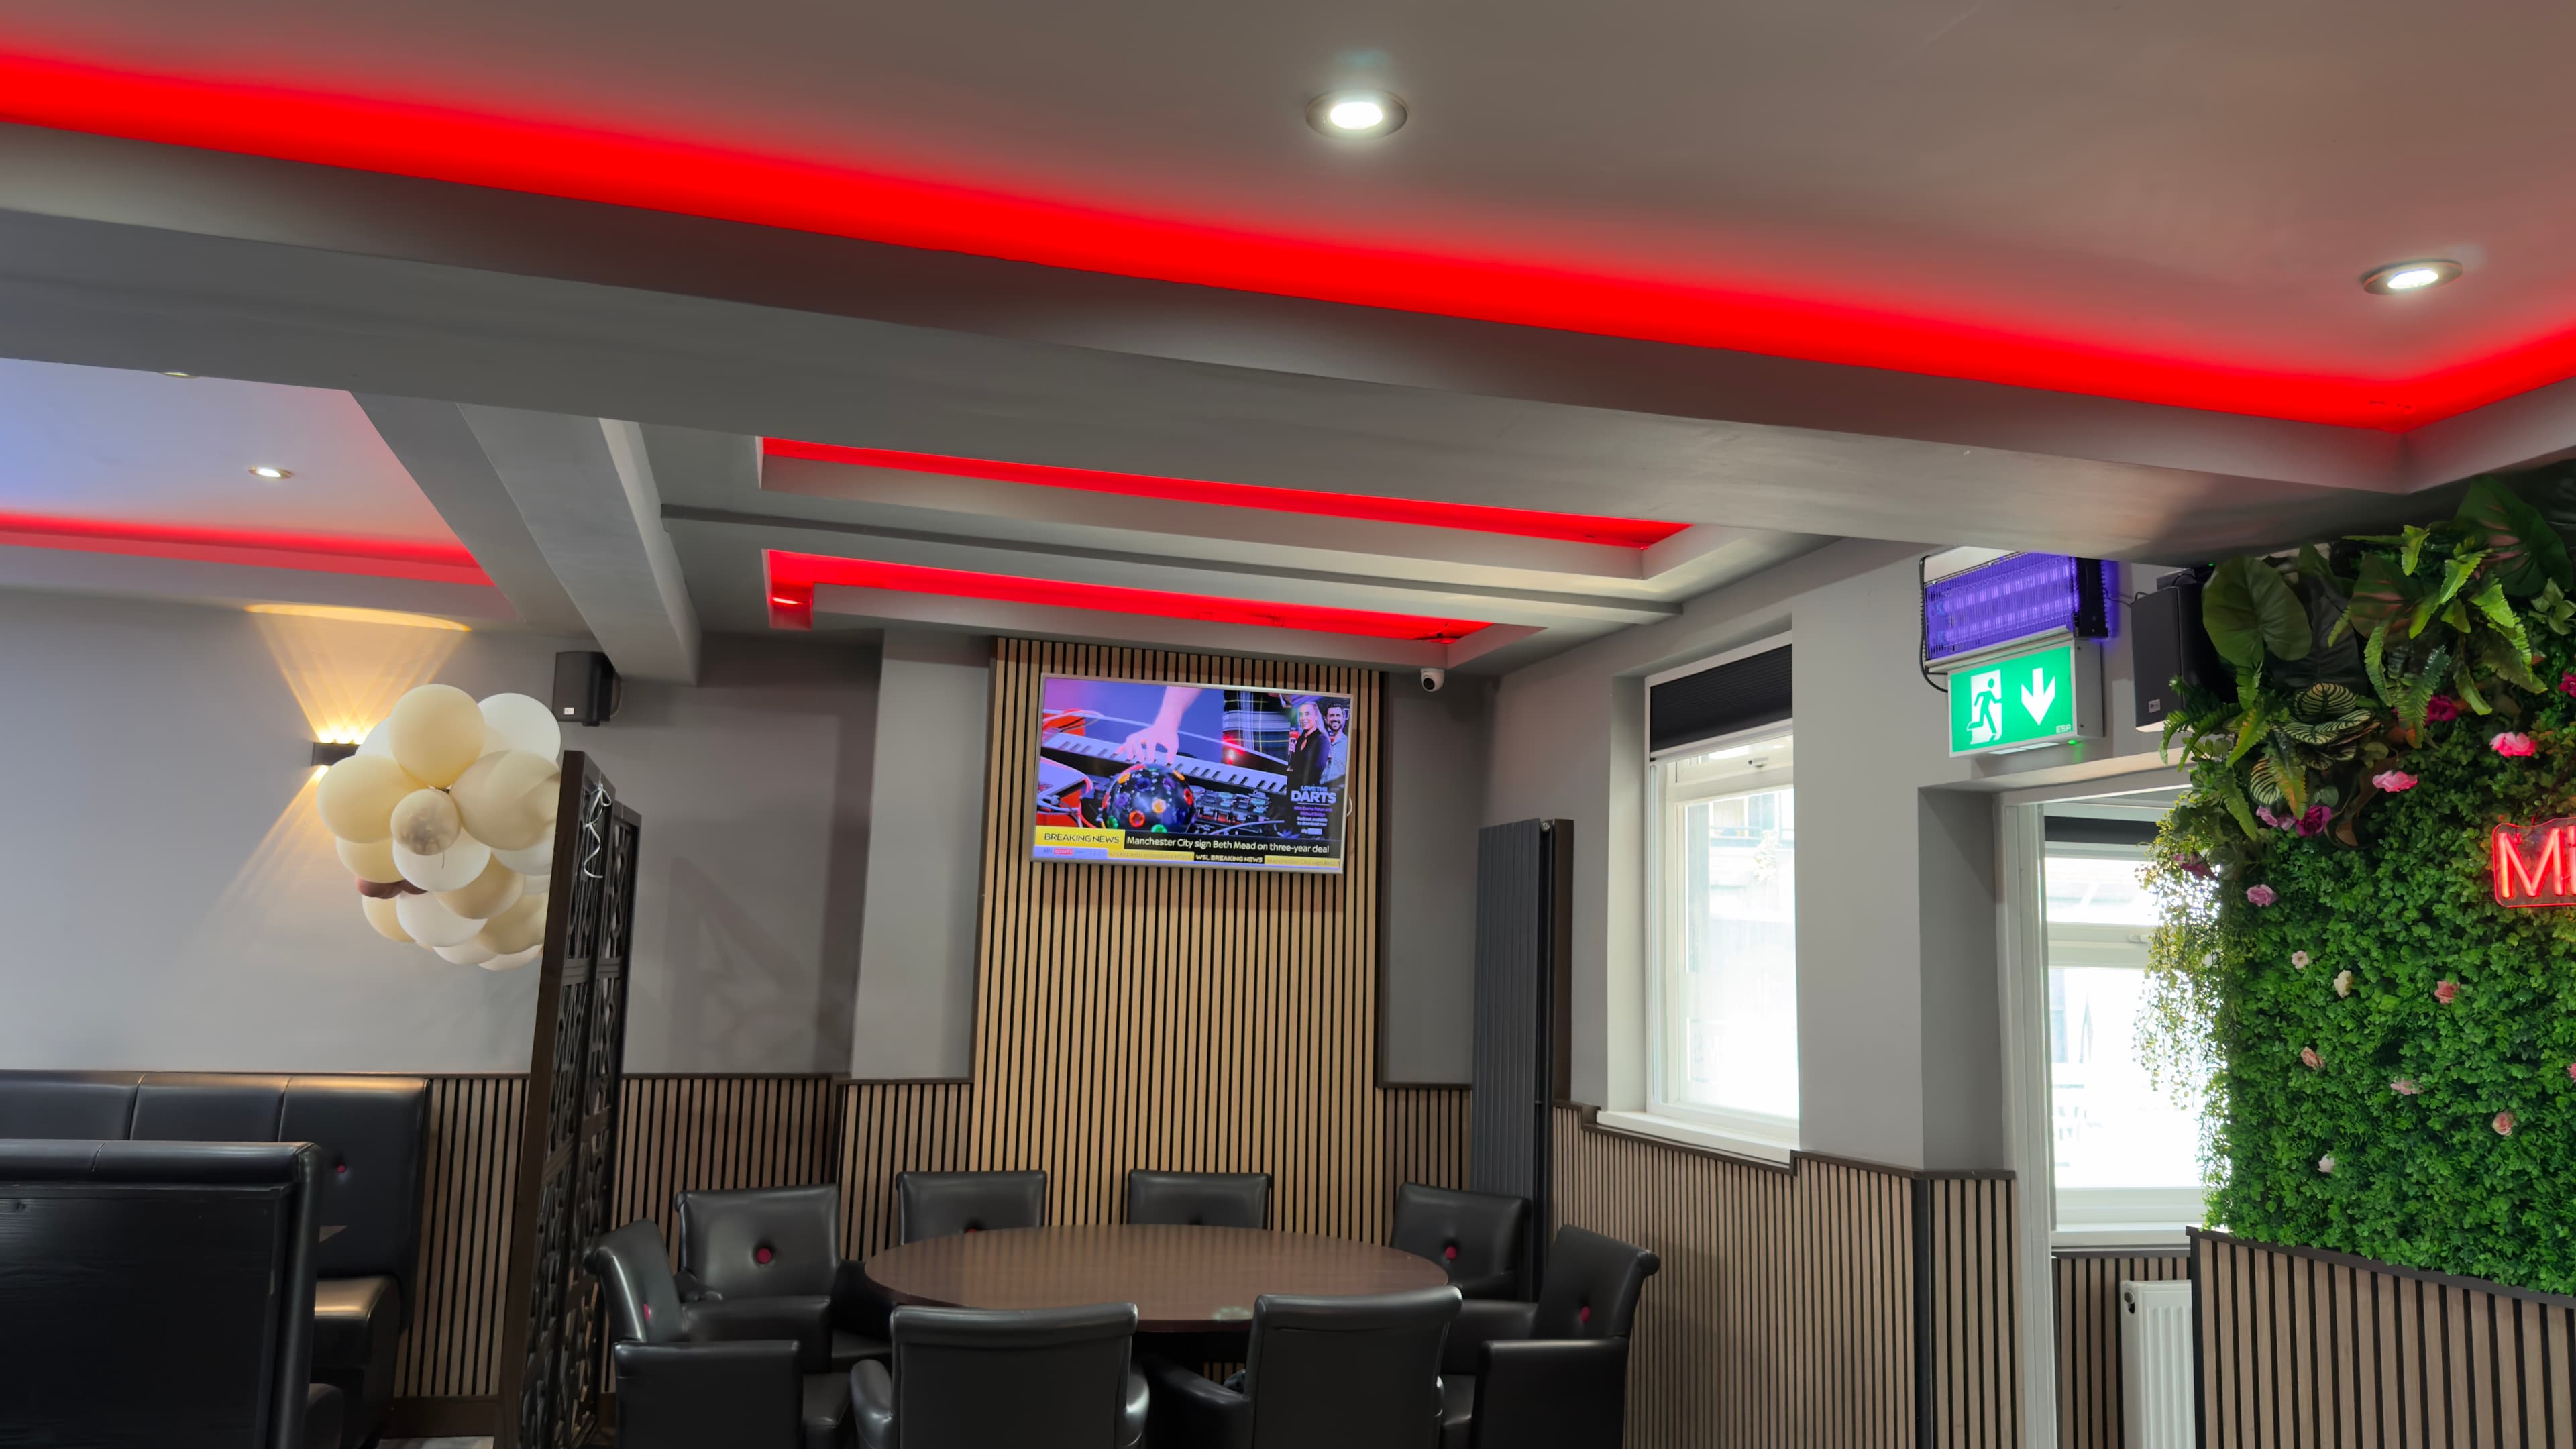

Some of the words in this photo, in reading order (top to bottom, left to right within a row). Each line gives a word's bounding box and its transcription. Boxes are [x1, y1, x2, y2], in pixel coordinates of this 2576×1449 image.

[1291, 790, 1337, 804] DARTS
[1044, 833, 1091, 843] BREAKING
[1092, 835, 1120, 843] NEWS
[1127, 836, 1176, 847] Manchester
[1177, 839, 1193, 849] City
[1194, 839, 1211, 849] sign
[1213, 840, 1232, 849] Beth
[1234, 841, 1256, 850] Mead
[1269, 843, 1311, 853] three-year
[1312, 845, 1330, 853] deal
